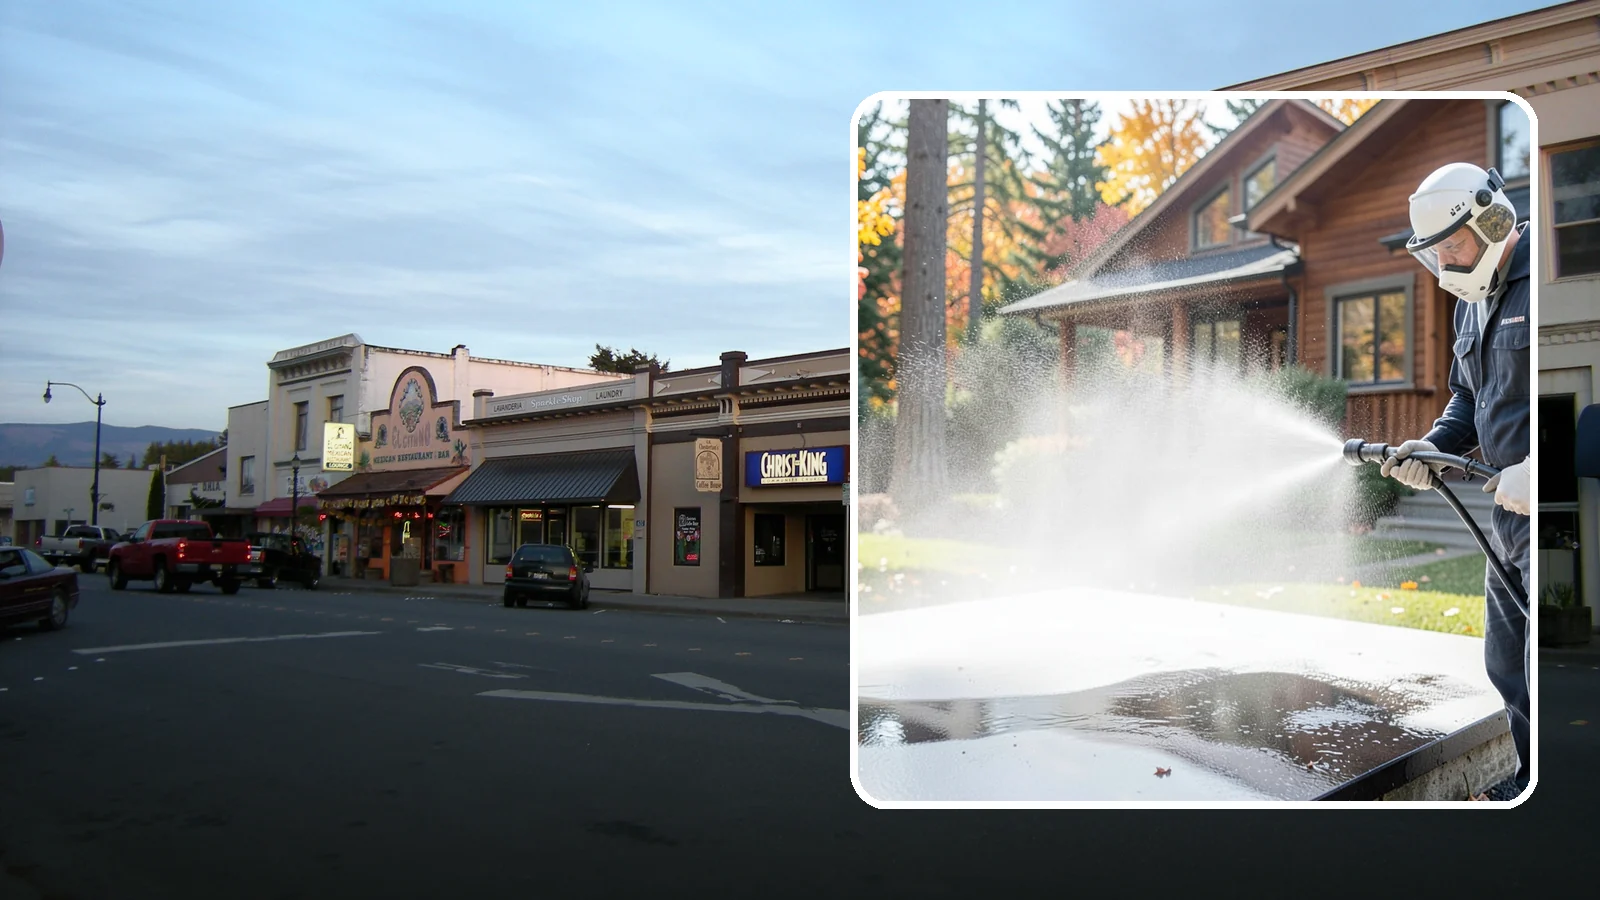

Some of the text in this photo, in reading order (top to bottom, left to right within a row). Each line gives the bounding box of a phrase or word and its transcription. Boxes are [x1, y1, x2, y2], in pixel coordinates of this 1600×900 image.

[595, 389, 623, 400] LAUNDRY
[493, 402, 522, 413] LAVANDERIA
[531, 395, 582, 409] Sparkle Shop
[374, 454, 396, 464] MEXICAN
[397, 451, 433, 462] RESTAURANT
[438, 450, 450, 459] BAR
[761, 450, 827, 478] CHRIST KING
